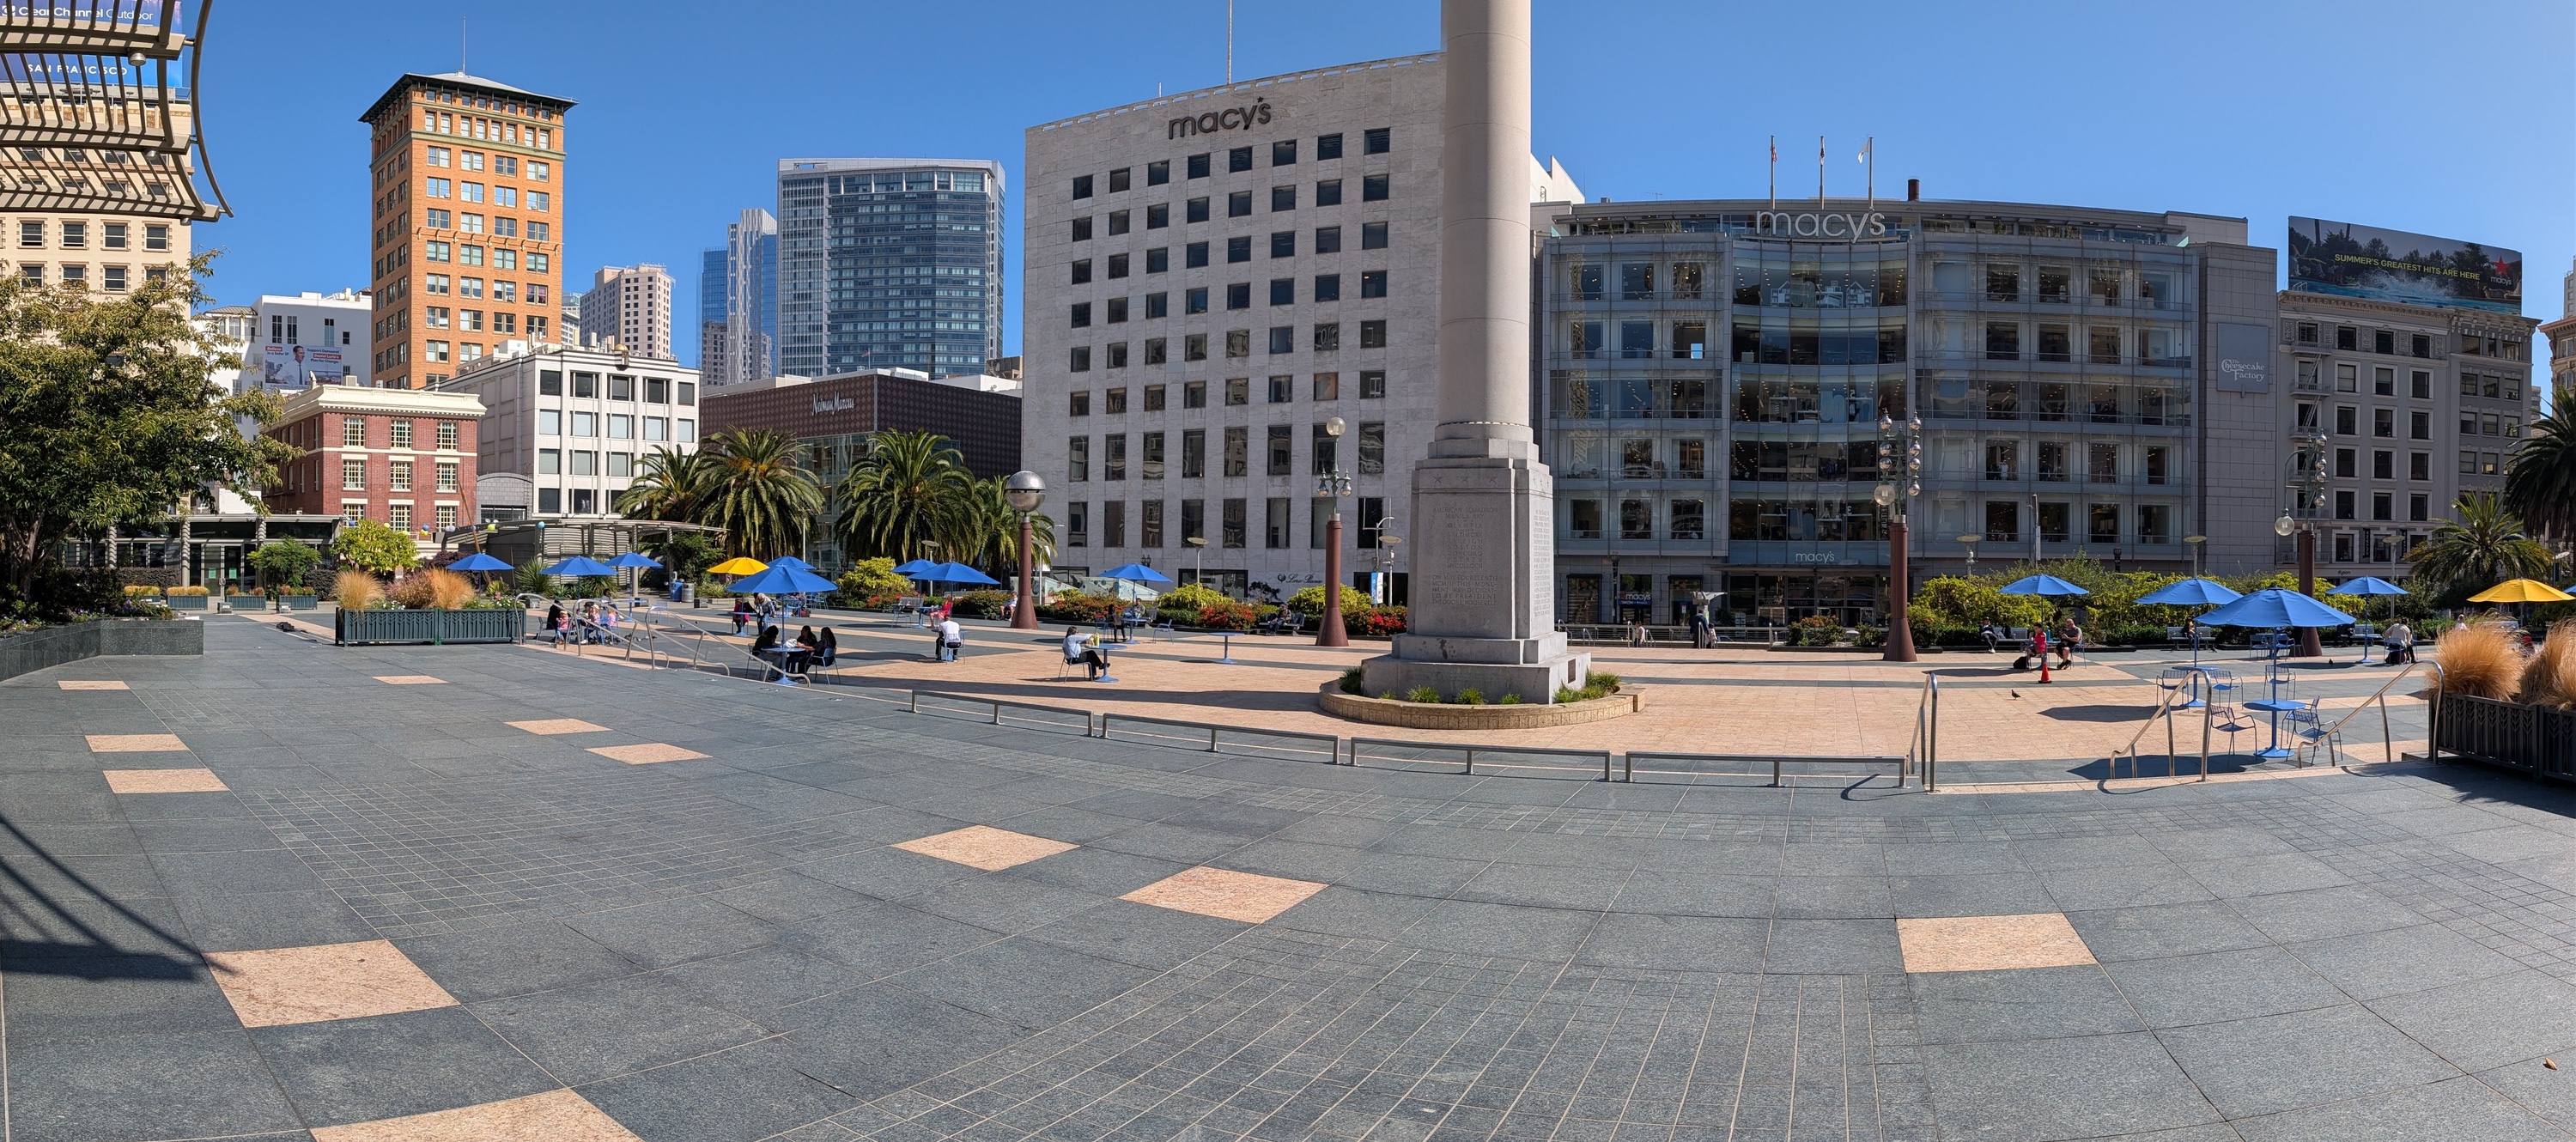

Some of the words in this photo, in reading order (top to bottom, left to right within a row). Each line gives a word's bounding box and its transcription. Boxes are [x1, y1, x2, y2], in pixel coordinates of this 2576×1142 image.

[18, 6, 51, 16] Cear
[57, 64, 127, 76] FRACSCO
[1169, 96, 1271, 140] macy's
[1756, 206, 1886, 243] macy's
[2335, 253, 2379, 266] SUMMER'S
[2380, 259, 2422, 273] GREATEST
[2423, 264, 2441, 275] HITS
[2442, 269, 2458, 277] ARE
[2459, 271, 2481, 281] HERE
[2490, 276, 2512, 287] macy's
[2221, 359, 2265, 373] Cheesecake
[2230, 368, 2265, 382] Factory
[1795, 550, 1835, 564] macy's
